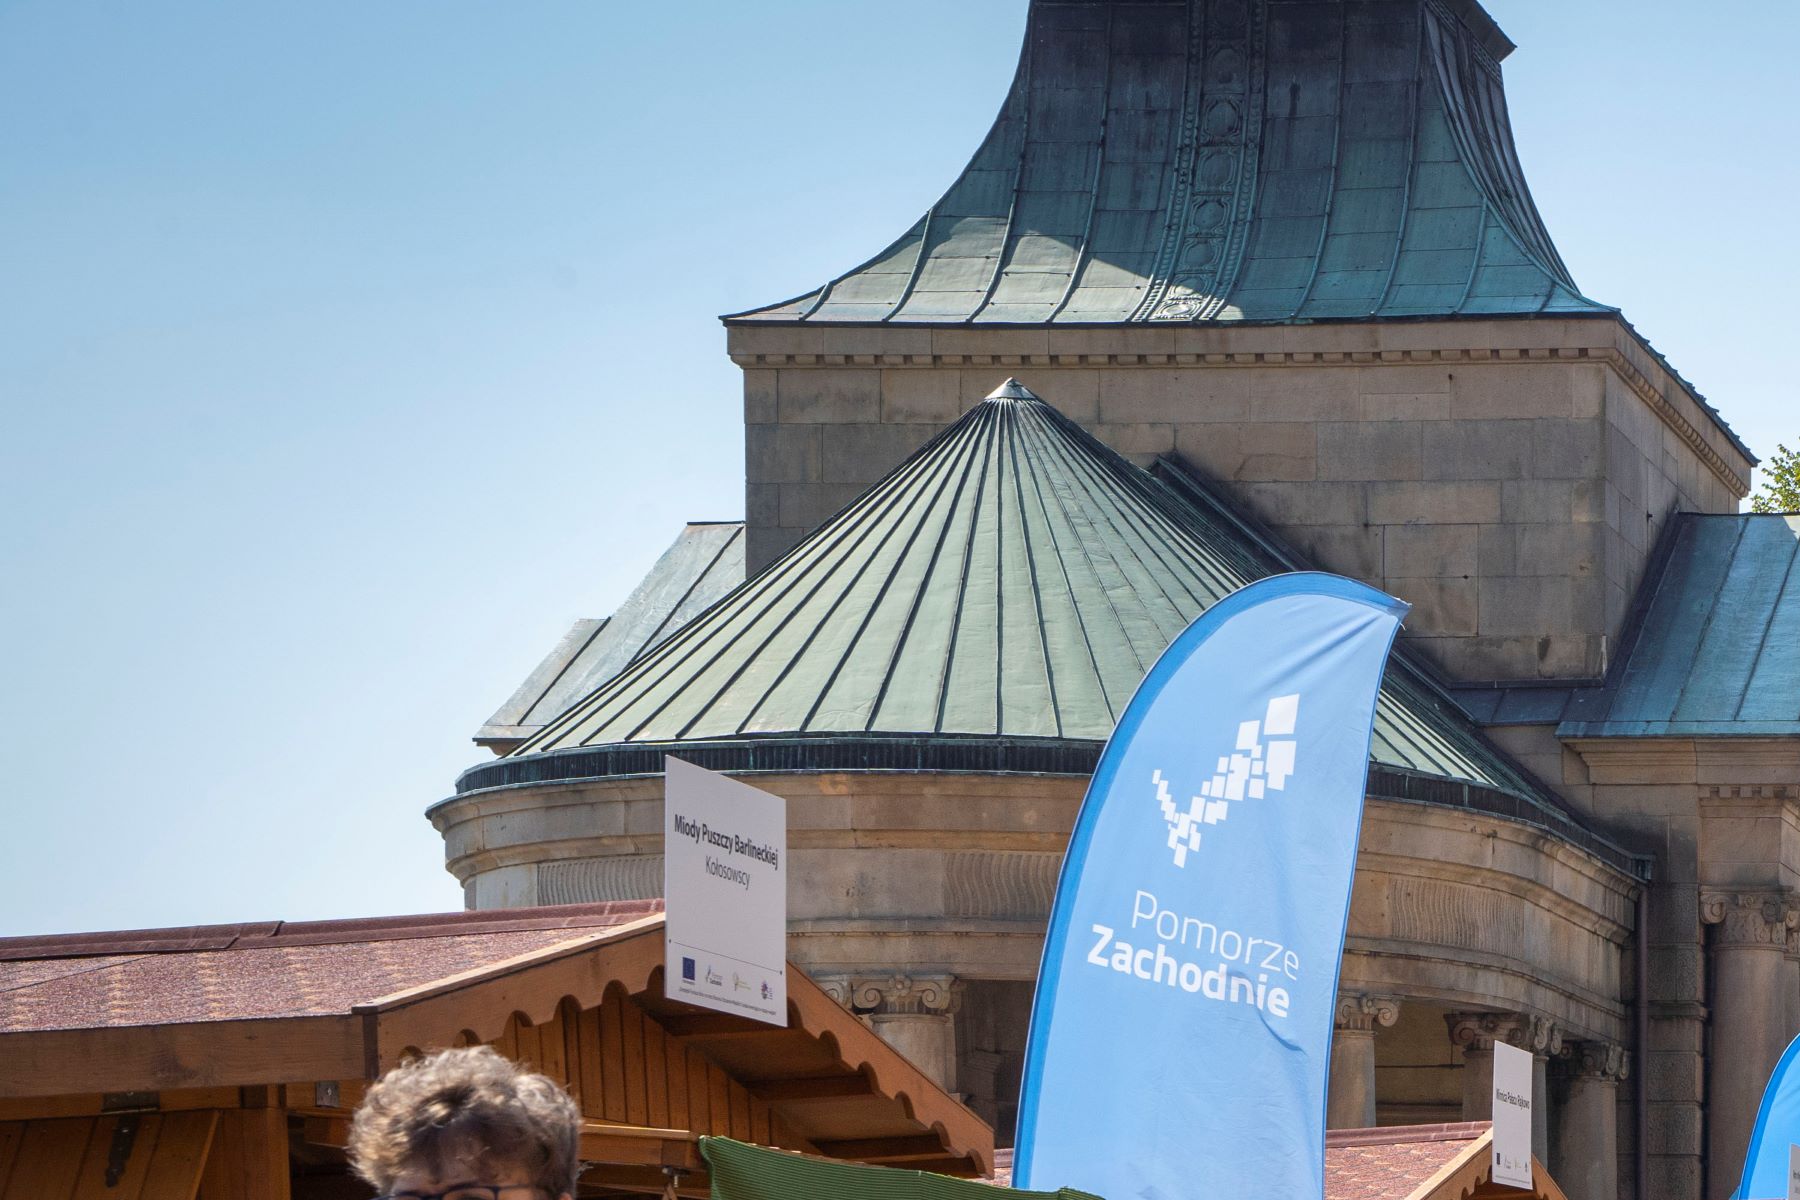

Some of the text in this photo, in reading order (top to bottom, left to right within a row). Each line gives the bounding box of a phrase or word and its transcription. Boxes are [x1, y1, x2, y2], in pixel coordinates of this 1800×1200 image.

[674, 813, 779, 871] Miody Puszczy Barlineckiej
[705, 855, 751, 891] Kołosowscy
[1087, 923, 1291, 1019] Zachodnie
[1131, 889, 1300, 981] Pomorze
